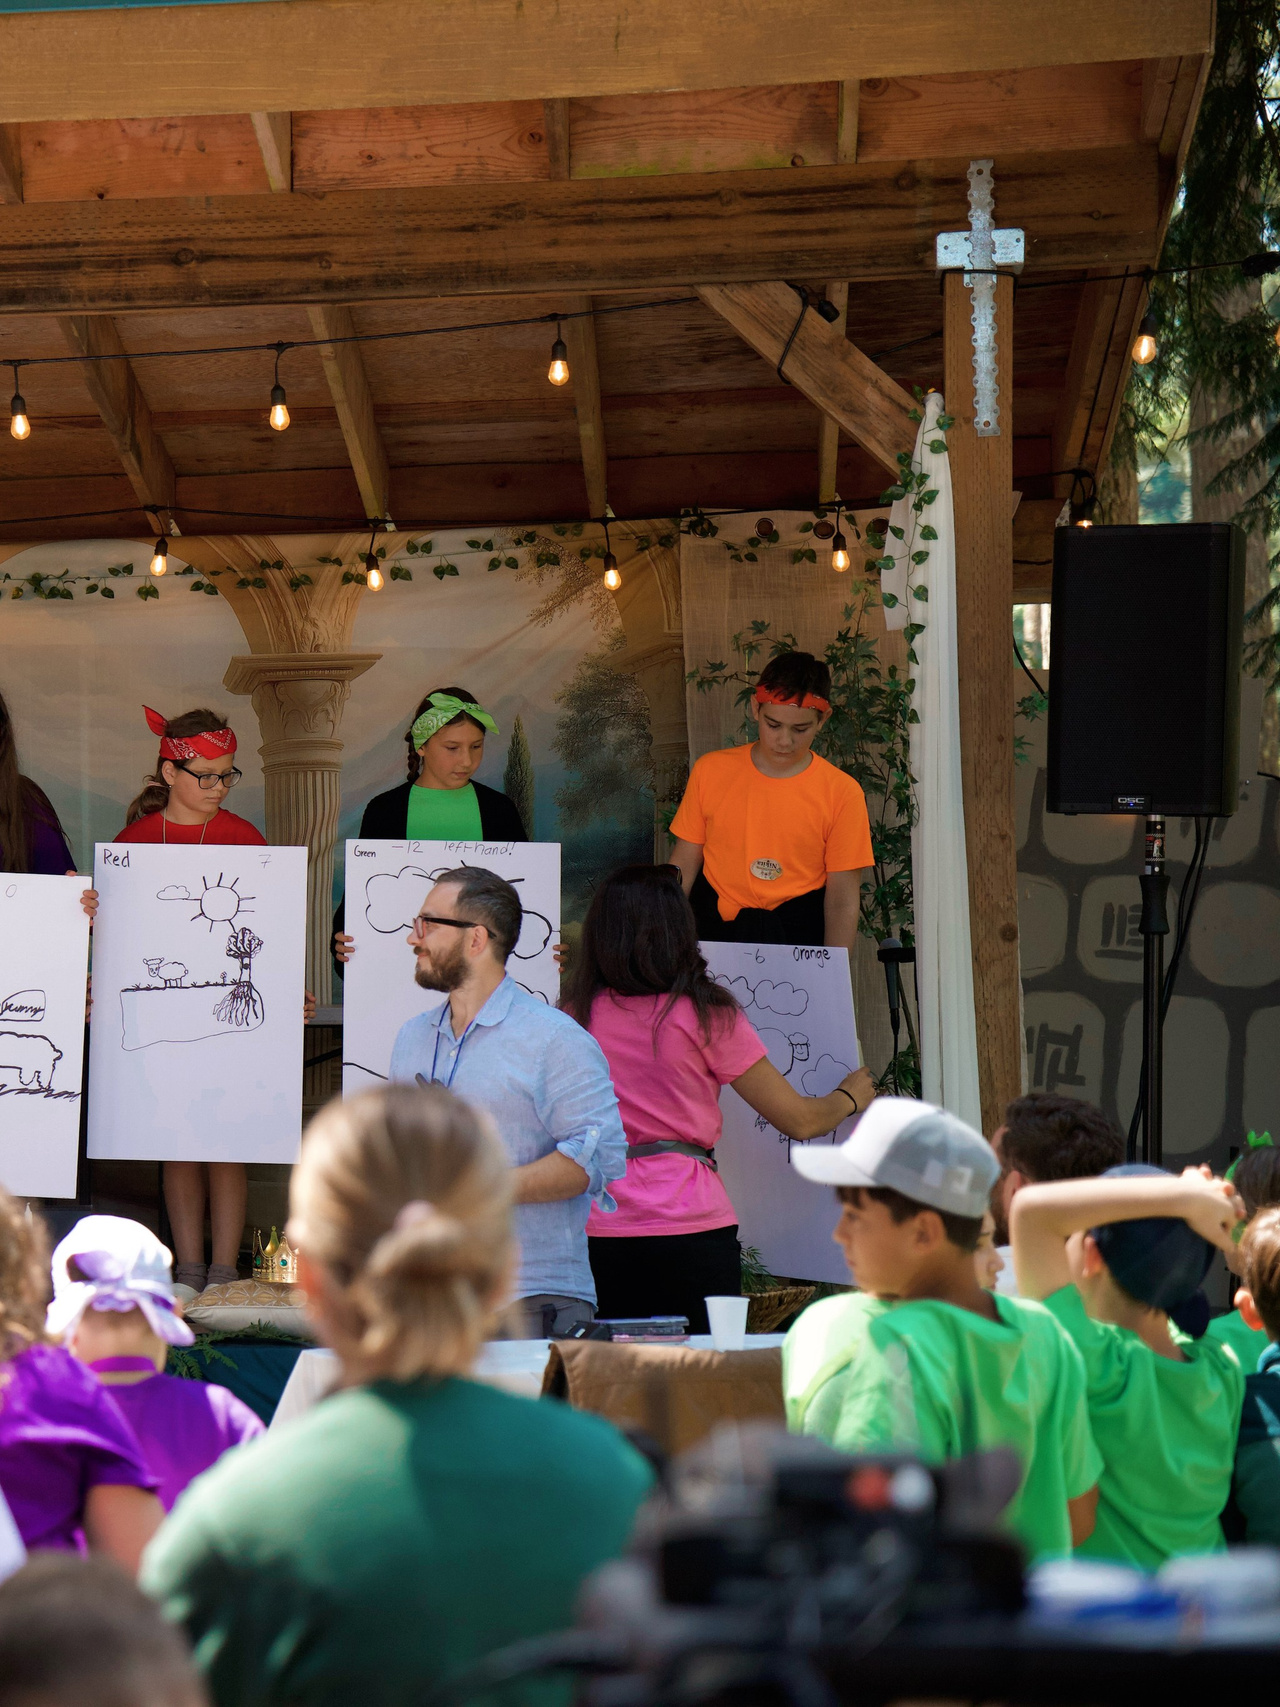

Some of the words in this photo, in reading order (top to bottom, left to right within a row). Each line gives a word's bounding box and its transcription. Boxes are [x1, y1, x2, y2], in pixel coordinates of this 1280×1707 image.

[103, 848, 131, 868] Red
[258, 853, 272, 869] 7
[353, 844, 377, 858] Green
[792, 946, 832, 969] Orange
